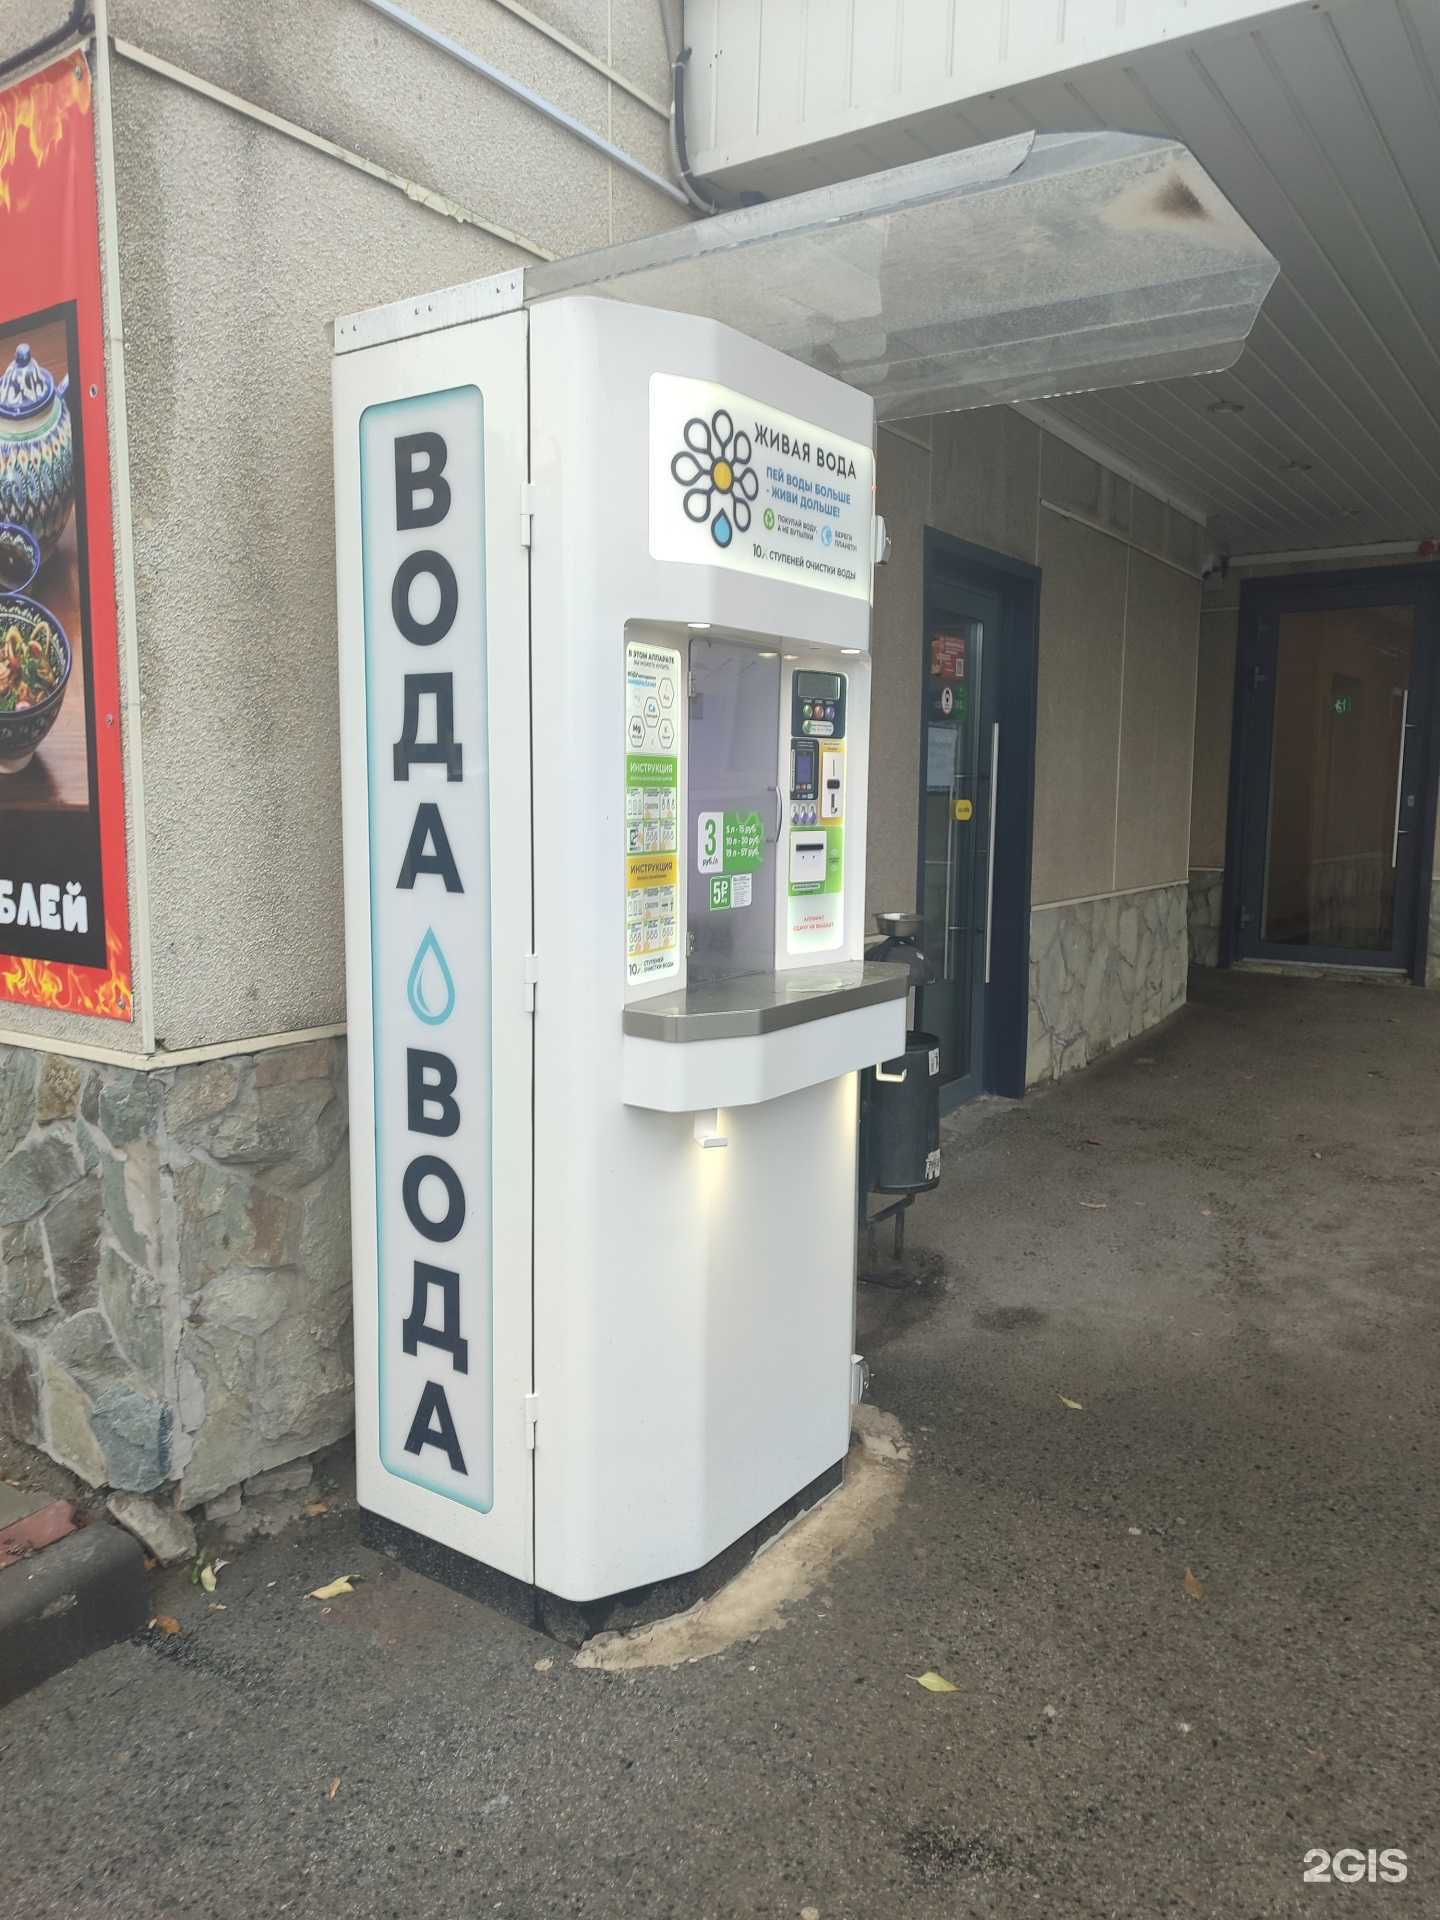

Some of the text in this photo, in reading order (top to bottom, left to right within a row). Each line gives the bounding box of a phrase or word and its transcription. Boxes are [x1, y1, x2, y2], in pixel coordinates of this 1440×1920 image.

[754, 422, 857, 480] ЖИВАЯ ВОДА
[766, 466, 851, 504] ПЕЙ ВОДЫ БОЛЬШЕ
[771, 486, 798, 505] ЖИВИ
[800, 497, 840, 518] ДОЛЬШЕ!
[769, 550, 804, 567] СТУПЕНЕЙ
[806, 561, 836, 576] ОЧИСТКИ
[837, 568, 856, 580] ВОДЫ
[391, 431, 464, 893] ВОДА
[630, 762, 673, 774] ИНСТРУКЦИЯ
[705, 819, 717, 855] 3
[630, 862, 673, 874] ИНСТРУКЦИЯ
[402, 1047, 469, 1476] ВОДА
